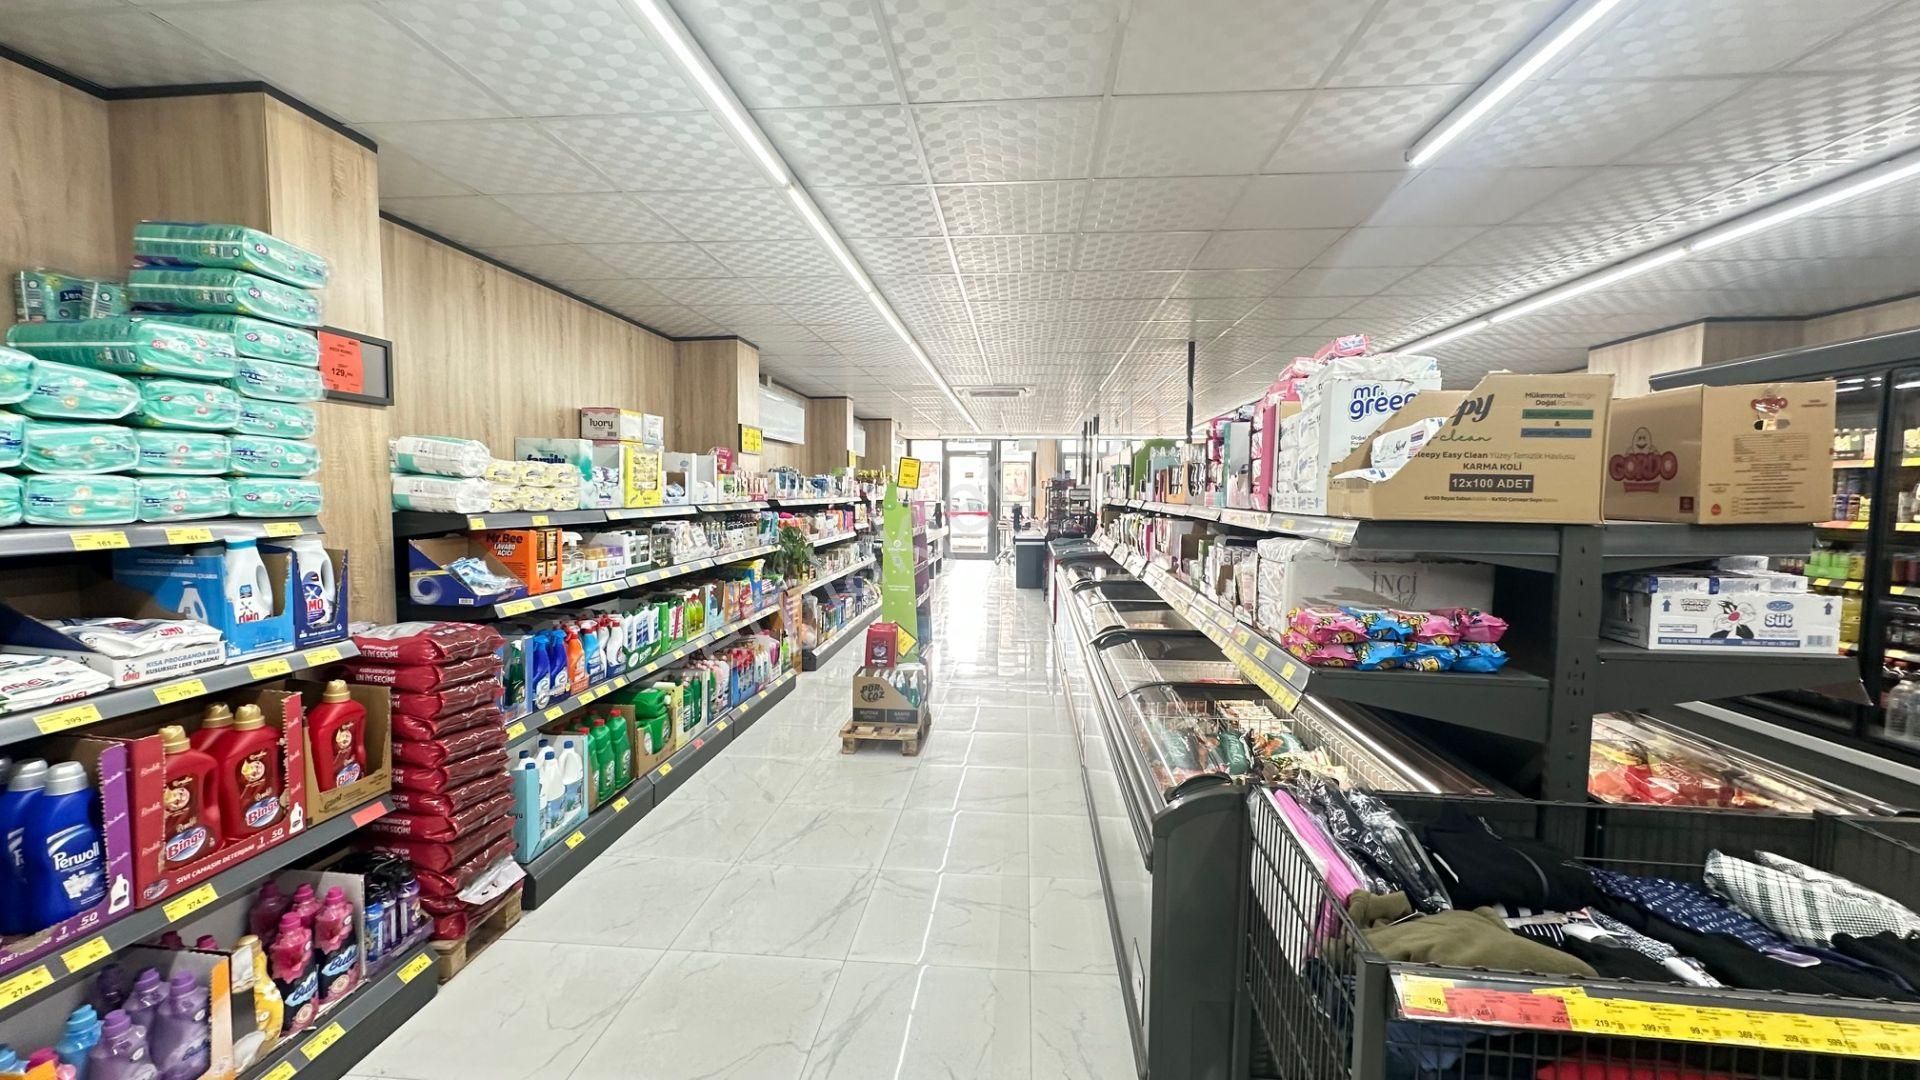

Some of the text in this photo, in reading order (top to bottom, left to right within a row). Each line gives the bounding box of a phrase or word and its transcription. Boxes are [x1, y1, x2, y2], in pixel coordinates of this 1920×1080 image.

[1354, 385, 1385, 399] mr.
[1452, 393, 1495, 426] py
[589, 418, 613, 429] Ivory
[1442, 452, 1462, 460] Easy
[1463, 462, 1522, 471] KARMA KOLİ
[1452, 478, 1531, 489] 12x100 ADET
[308, 598, 323, 612] MO
[247, 799, 281, 826] Bingo
[271, 828, 284, 837] 50
[166, 827, 207, 861] Bingo
[53, 841, 100, 871] Perwoll
[81, 911, 98, 926] 50
